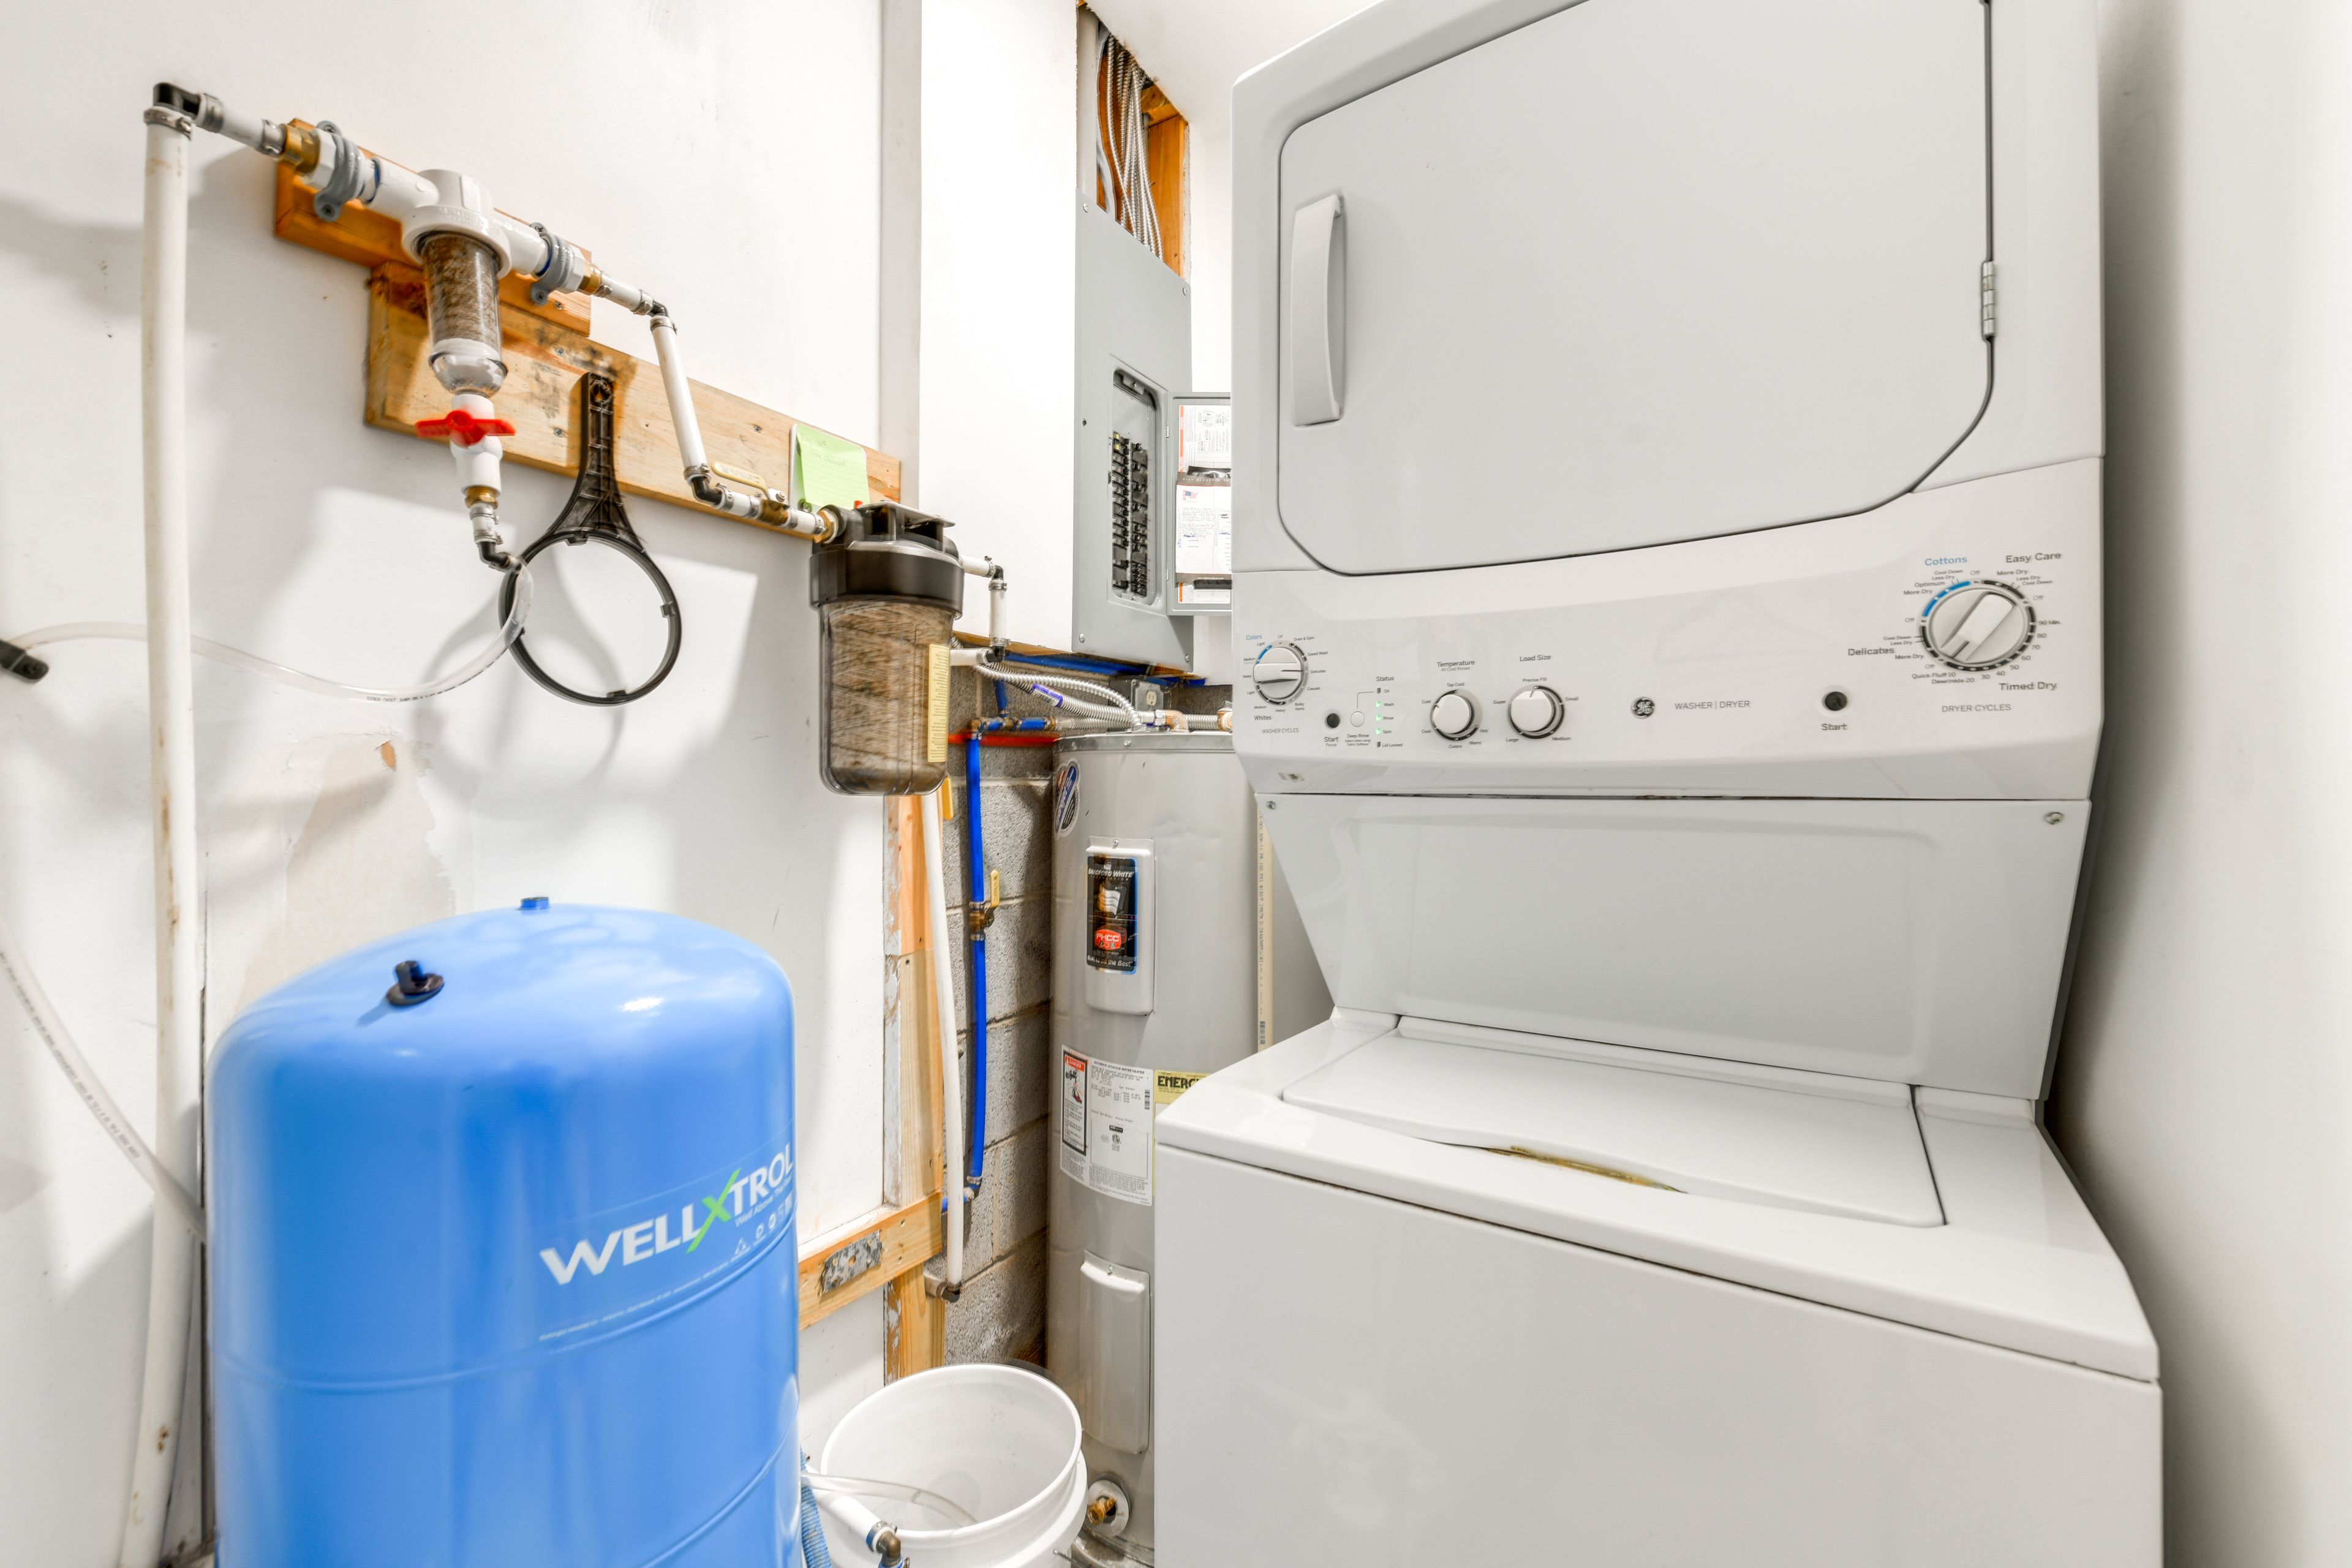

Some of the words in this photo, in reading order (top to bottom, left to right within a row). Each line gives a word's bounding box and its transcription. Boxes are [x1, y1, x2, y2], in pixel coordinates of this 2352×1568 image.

[1924, 557, 1967, 566] Cottons
[1848, 647, 1894, 656] Delicates
[1999, 682, 2034, 690] Timed
[2037, 682, 2057, 691] Dry
[1719, 700, 1750, 709] DRYER
